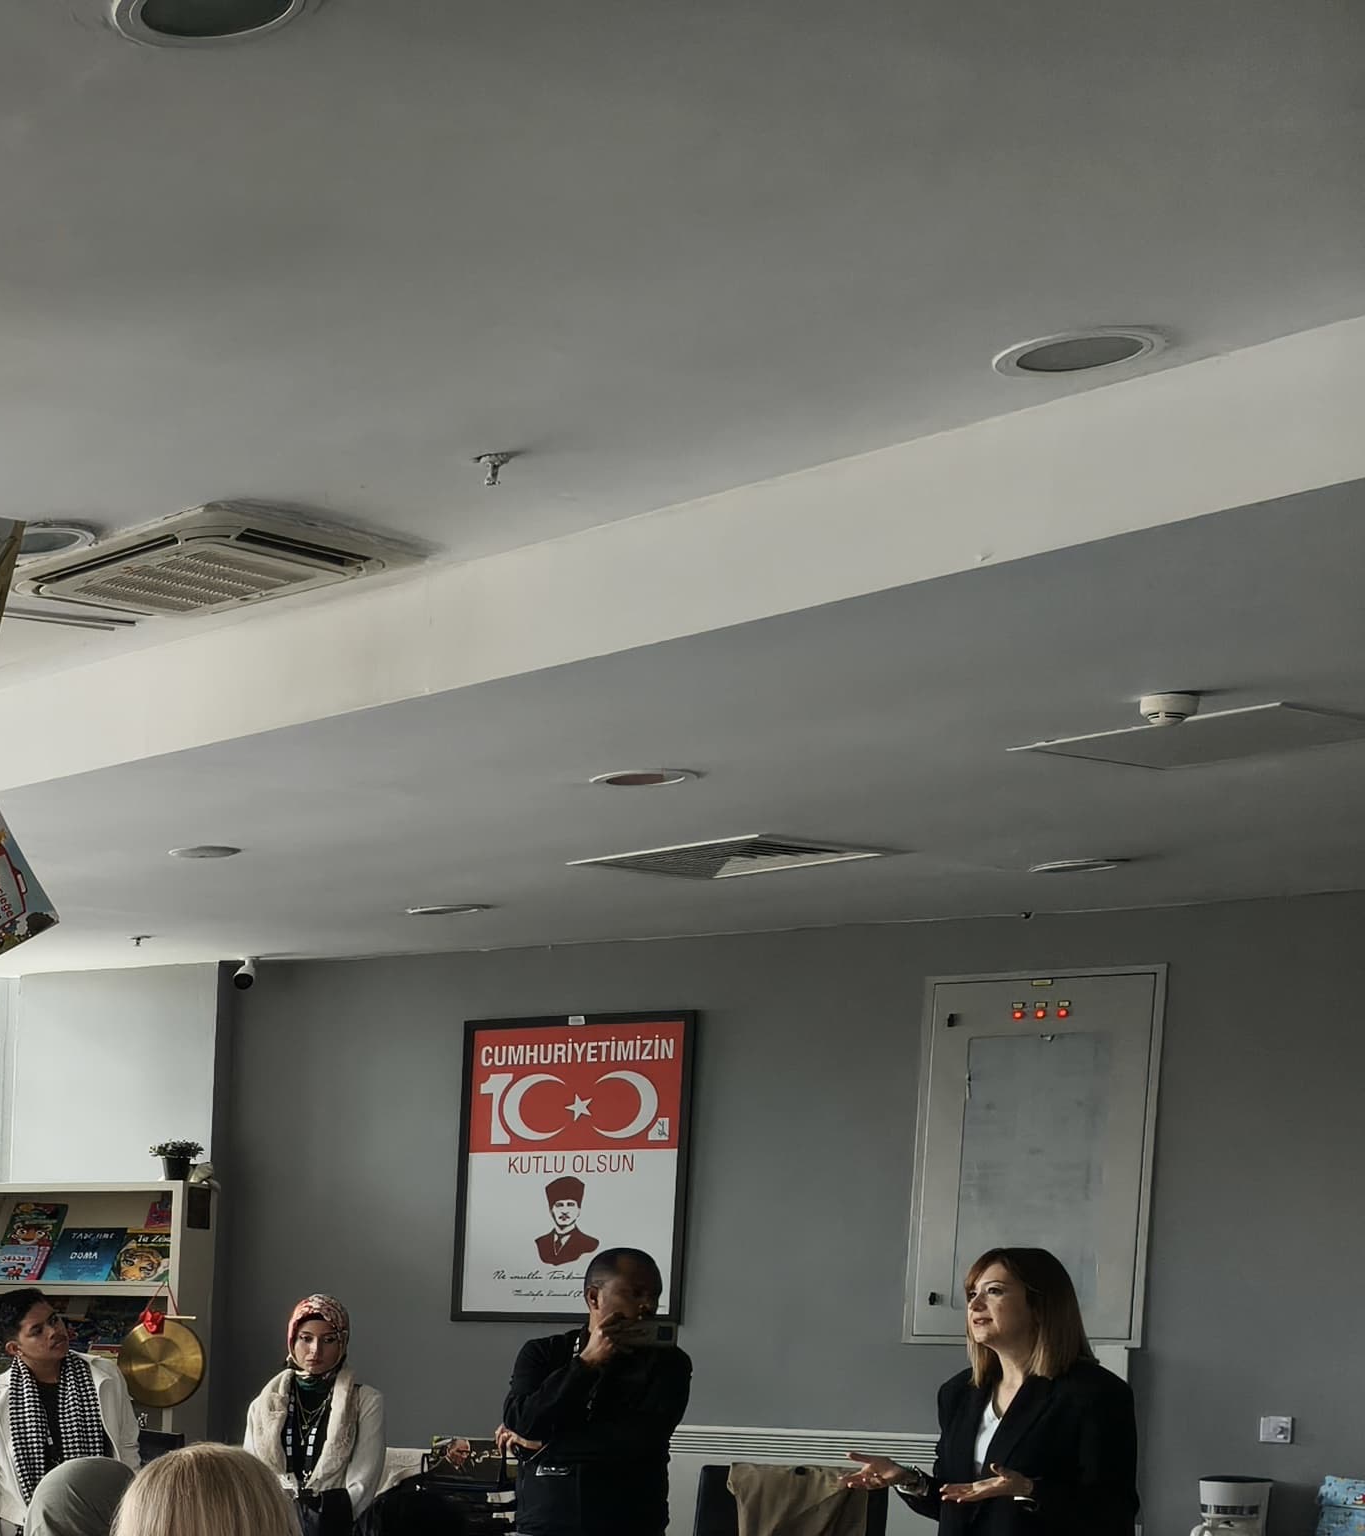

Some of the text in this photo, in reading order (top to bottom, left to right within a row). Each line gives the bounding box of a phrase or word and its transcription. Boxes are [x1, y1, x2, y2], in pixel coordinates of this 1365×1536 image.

[481, 1034, 675, 1068] CUMHURİYETİMİZİN
[508, 1153, 635, 1175] KUTLU OLSUN
